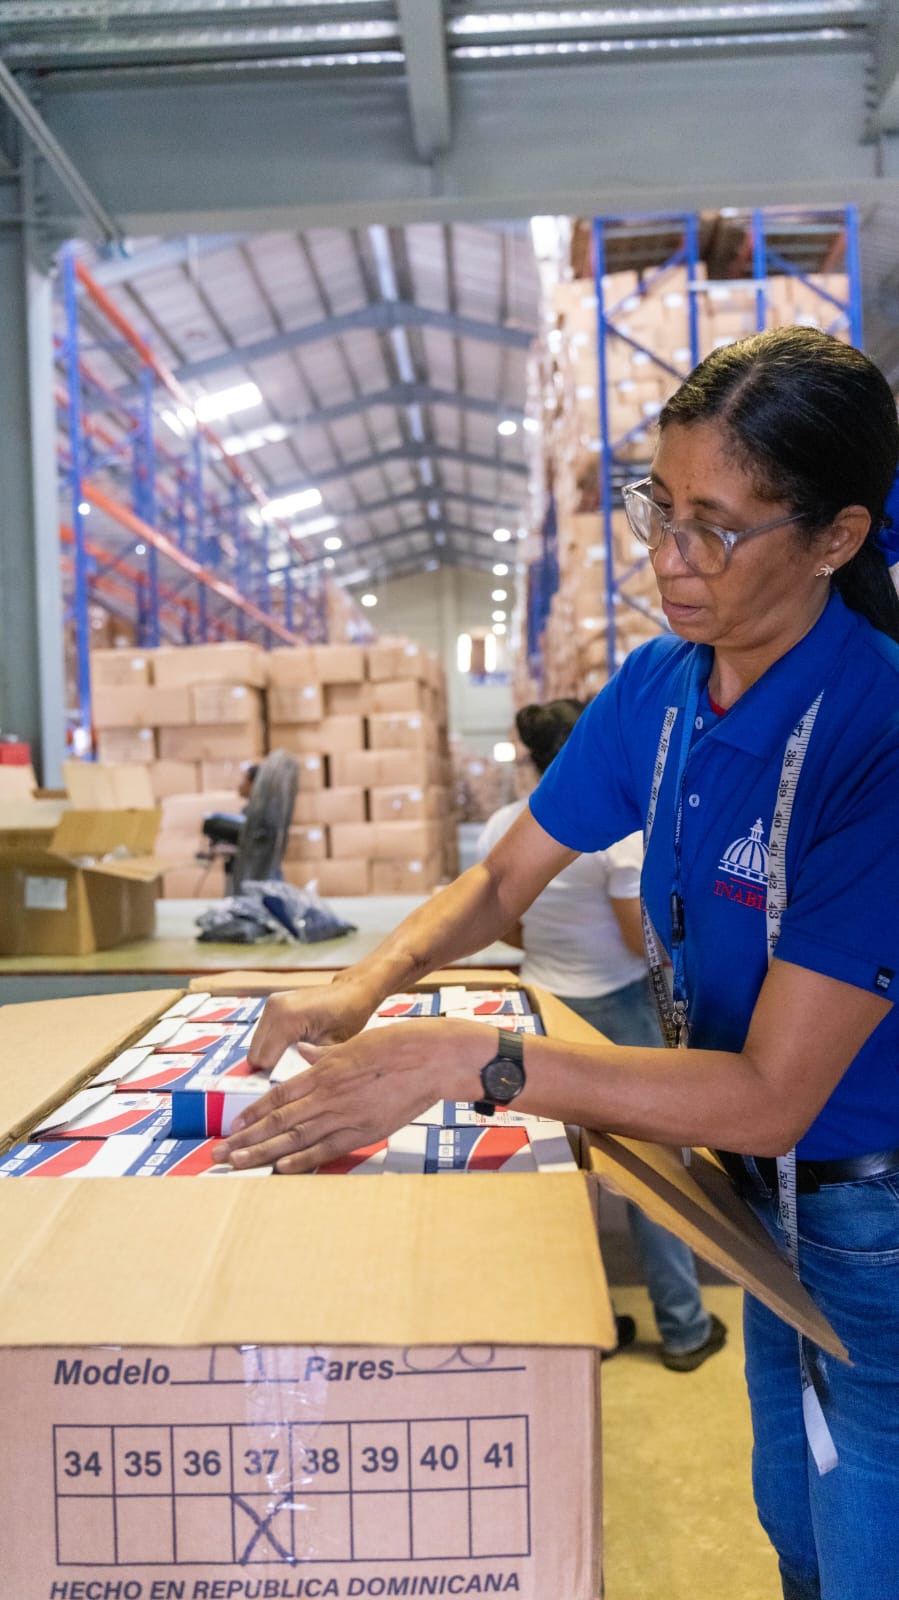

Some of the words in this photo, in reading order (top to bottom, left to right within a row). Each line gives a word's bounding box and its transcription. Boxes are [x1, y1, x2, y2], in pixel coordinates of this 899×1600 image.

[784, 749, 797, 767] 38
[779, 780, 789, 798] 39
[773, 810, 783, 828] 40
[770, 840, 779, 857] 41
[768, 871, 778, 889] 42
[713, 879, 769, 912] INABI
[768, 902, 780, 919] 43
[779, 1170, 789, 1189] 52
[53, 1358, 170, 1385] Modelo
[304, 1355, 395, 1384] Pares
[64, 1451, 102, 1477] 34
[124, 1451, 162, 1477] 35
[183, 1450, 221, 1476] 36
[243, 1449, 280, 1476] 37
[301, 1448, 340, 1474] 38
[361, 1446, 399, 1473] 39
[420, 1444, 459, 1471] 40
[484, 1442, 515, 1469] 41
[50, 1580, 143, 1600] HECHO
[149, 1581, 185, 1600] EN
[191, 1577, 339, 1600] REPUBLICA
[346, 1573, 520, 1597] DOMINICANA
